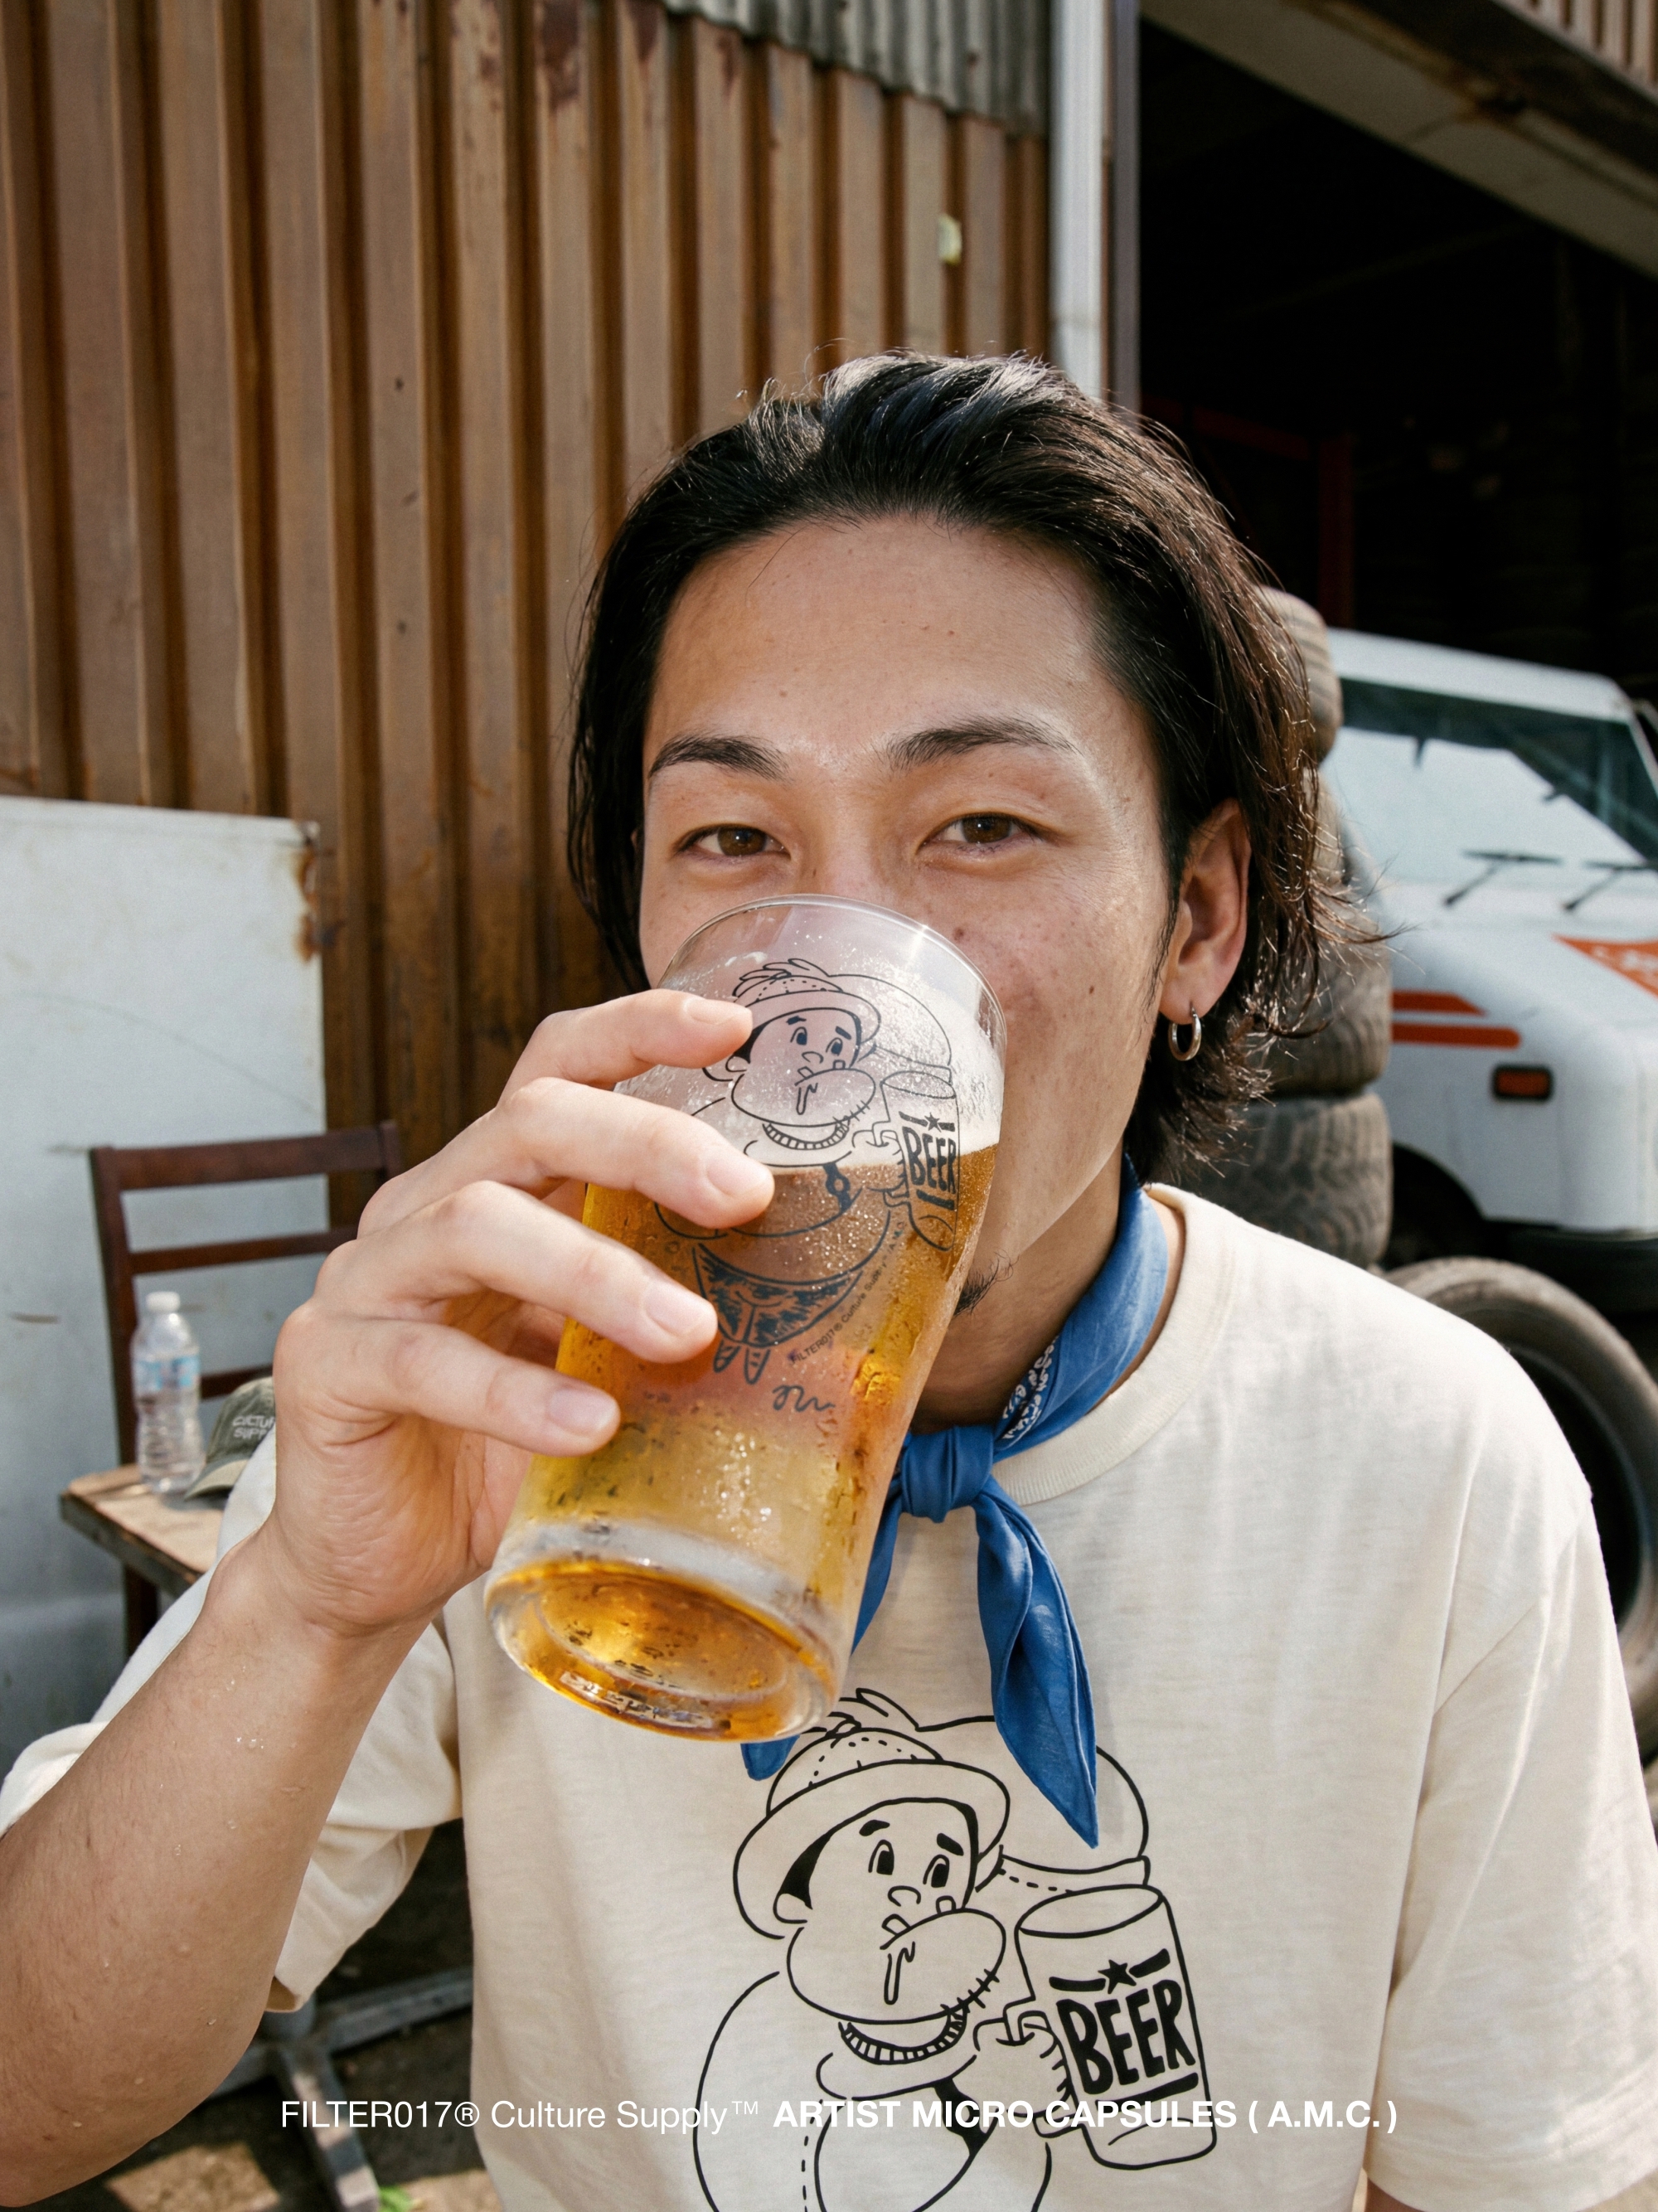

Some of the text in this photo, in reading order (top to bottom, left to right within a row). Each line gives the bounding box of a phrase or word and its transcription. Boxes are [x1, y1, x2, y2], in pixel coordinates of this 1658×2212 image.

[901, 1125, 957, 1195] BEER
[841, 1292, 867, 1324] Culture
[1055, 1978, 1196, 2095] BEER
